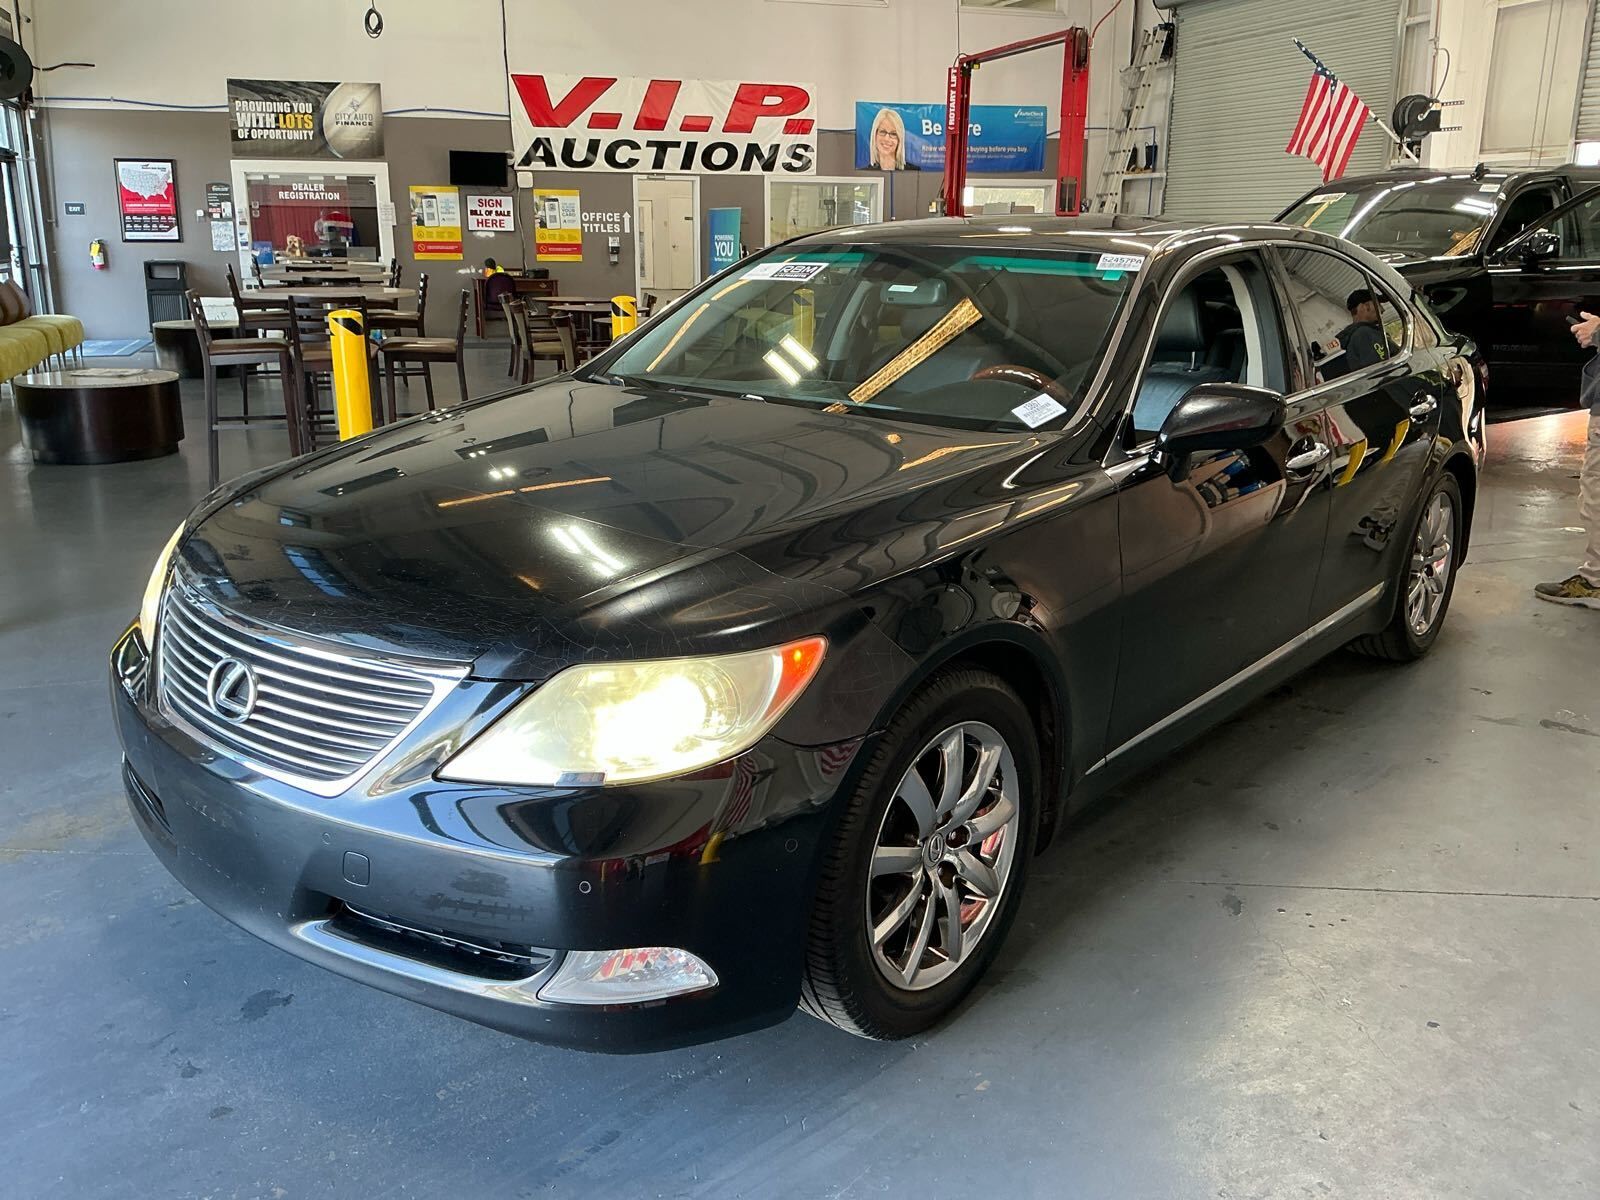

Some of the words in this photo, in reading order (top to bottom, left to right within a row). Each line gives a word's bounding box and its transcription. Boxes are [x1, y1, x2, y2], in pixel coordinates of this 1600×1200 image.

[235, 100, 292, 113] PROVIDING
[293, 102, 313, 113] YOU
[510, 74, 815, 135] V.I.P.
[236, 112, 276, 129] WITH
[278, 113, 314, 129] LOTS
[335, 112, 351, 121] CITY
[353, 113, 374, 121] AUTO
[921, 119, 942, 135] Be
[967, 123, 982, 136] re
[237, 129, 250, 139] OF
[250, 129, 314, 140] OPPORTUNITY
[517, 136, 815, 173] AUCTIONS
[292, 183, 325, 192] DEALER
[278, 191, 340, 201] REGISTRATION
[477, 198, 503, 208] SIGN
[469, 209, 484, 217] BILL
[485, 209, 493, 217] OF
[581, 212, 620, 222] OFFICE
[476, 218, 506, 228] HERE
[582, 223, 621, 233] TITLES
[714, 241, 734, 257] YOU
[779, 265, 819, 274] RBM
